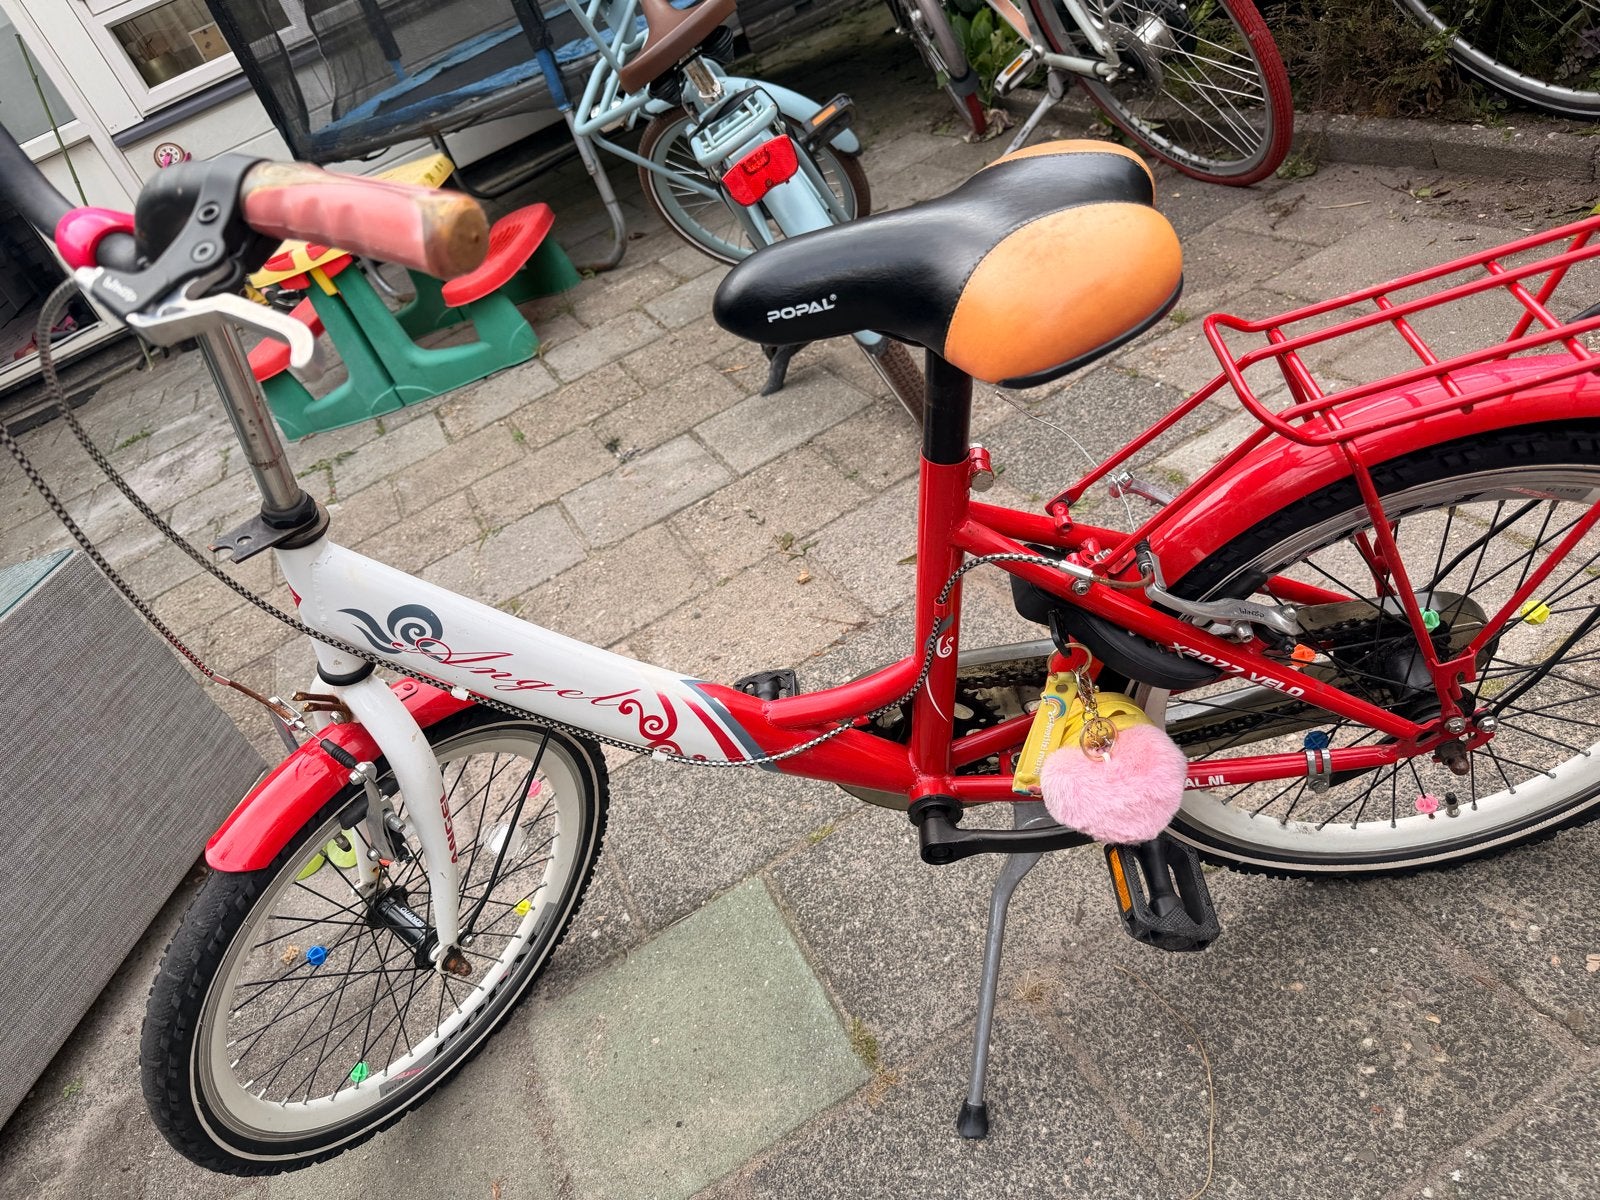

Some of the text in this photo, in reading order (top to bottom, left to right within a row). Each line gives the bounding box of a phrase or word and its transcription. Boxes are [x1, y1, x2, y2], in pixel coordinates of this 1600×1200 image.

[391, 637, 642, 707] Angel
[1168, 641, 1305, 697] X2077 VELO
